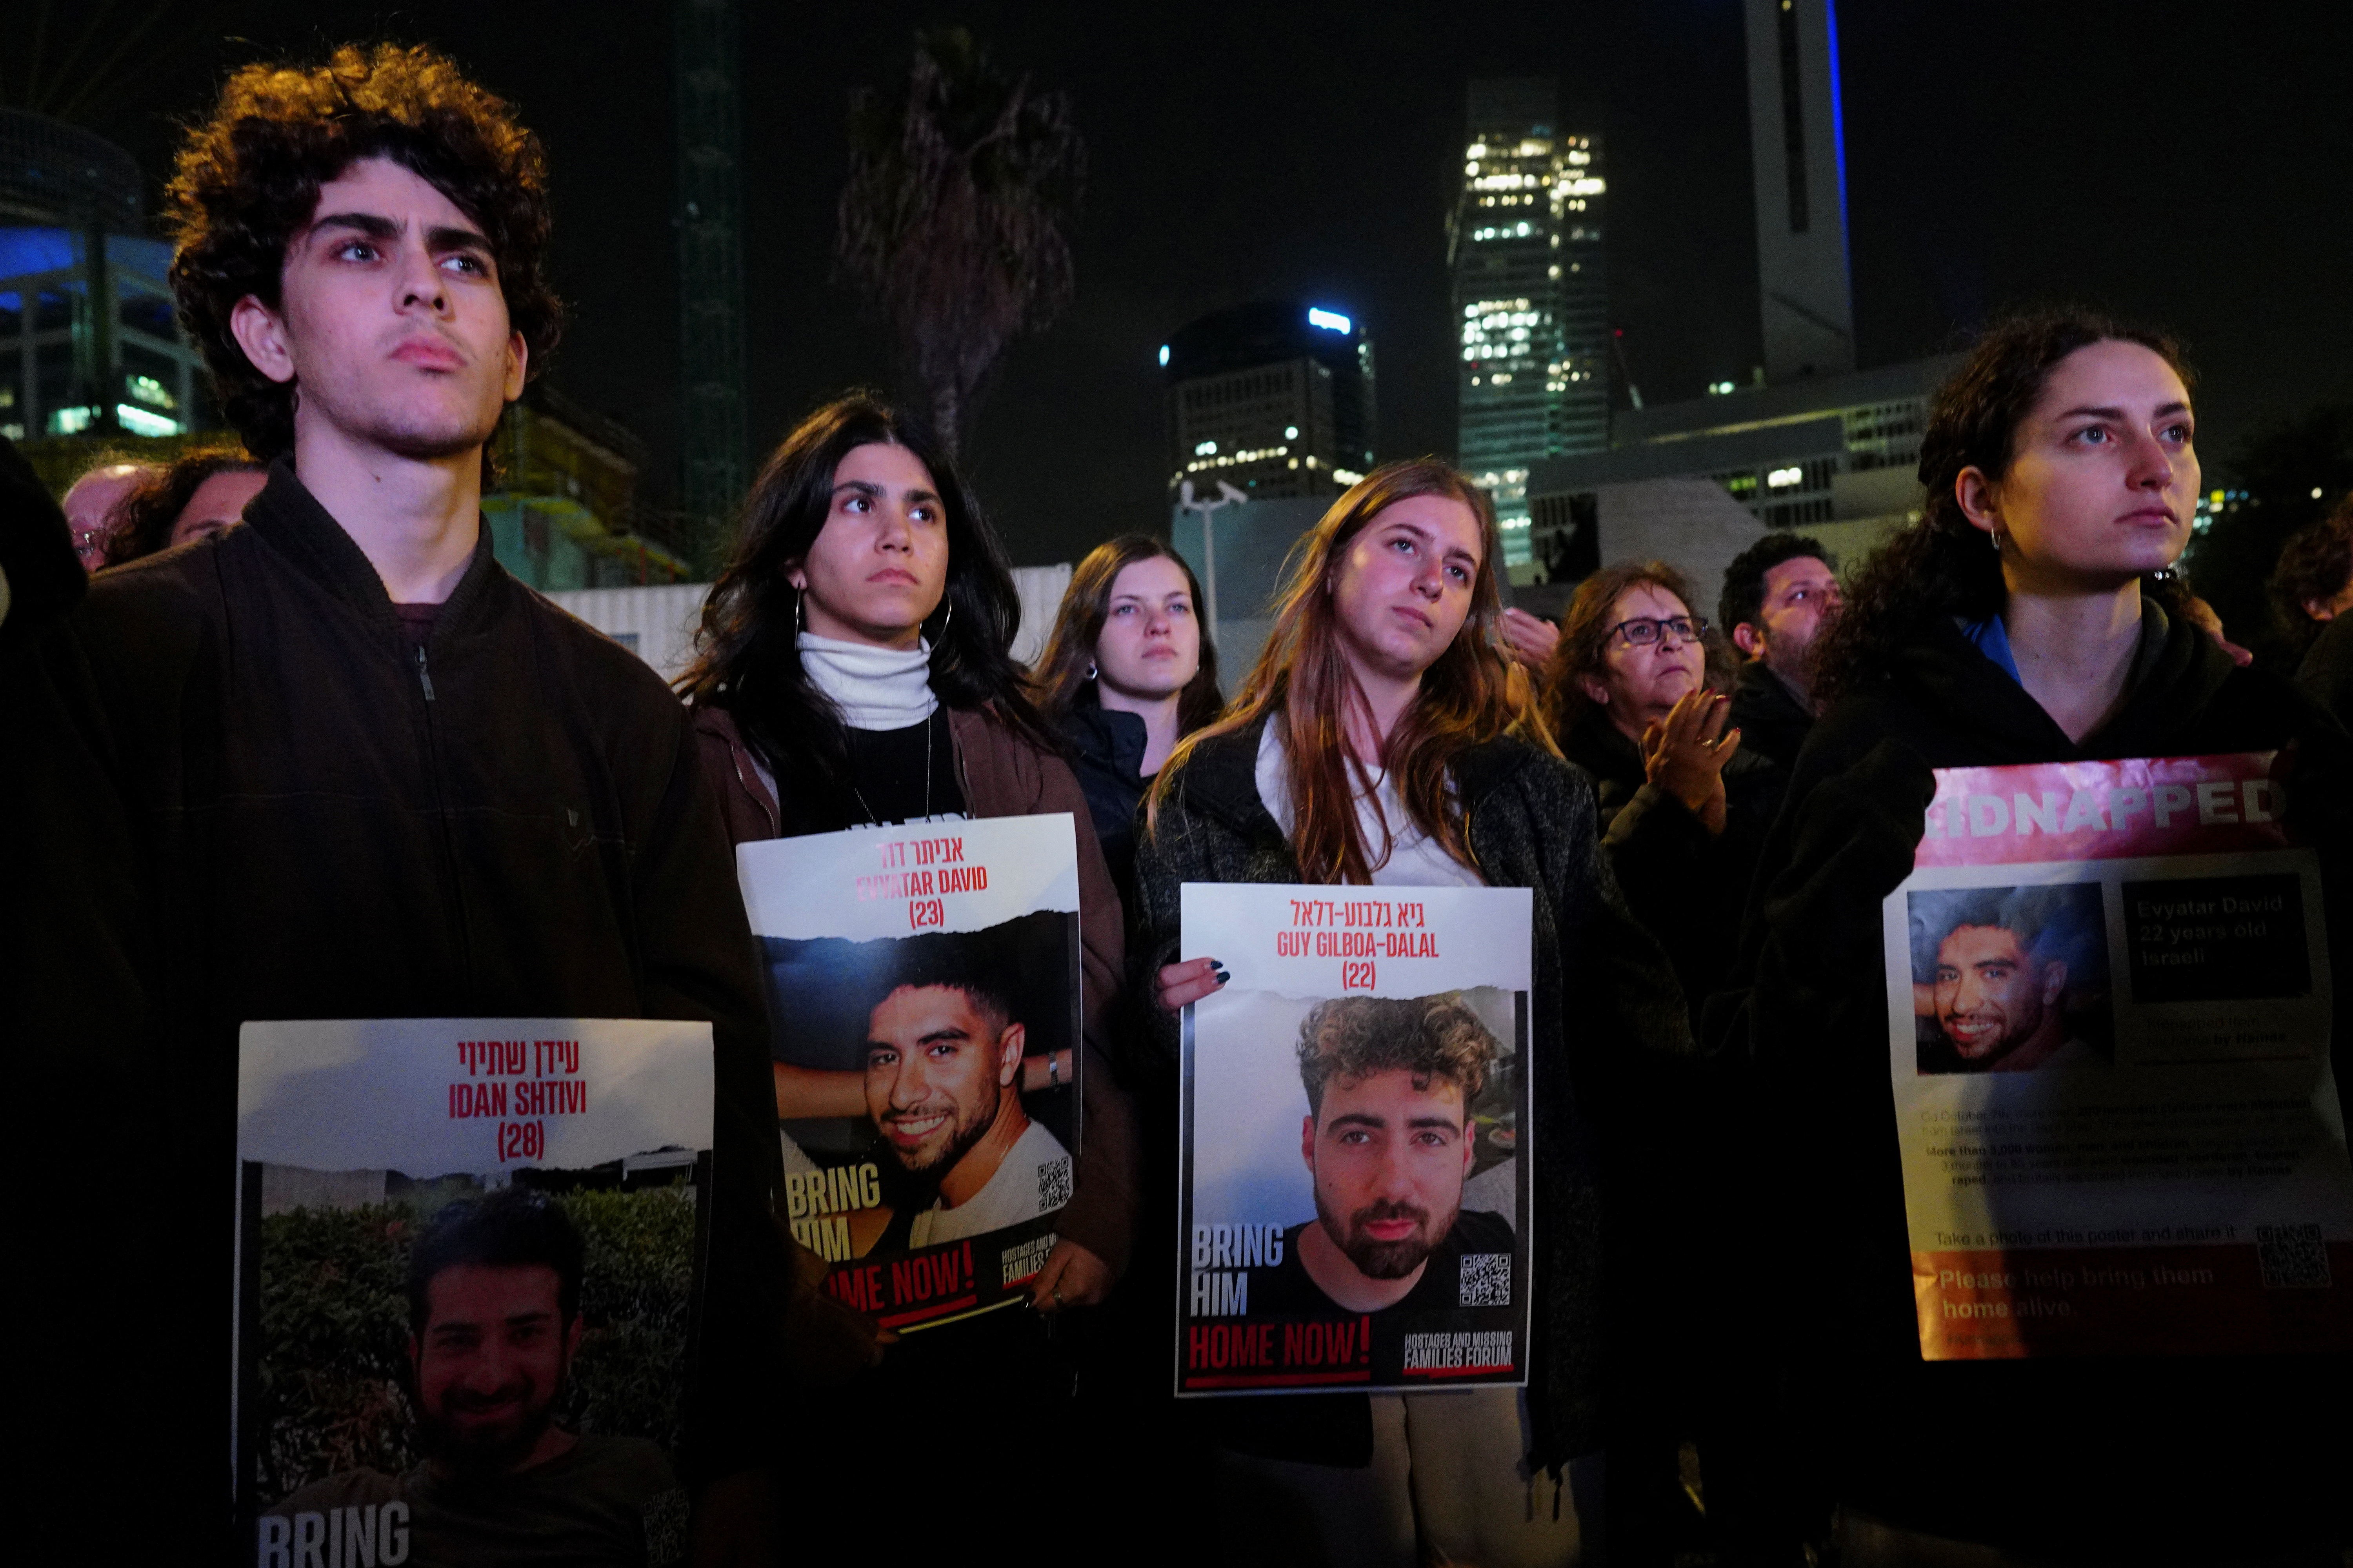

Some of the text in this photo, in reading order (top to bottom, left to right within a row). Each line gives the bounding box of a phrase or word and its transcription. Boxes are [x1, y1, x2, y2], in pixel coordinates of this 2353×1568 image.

[876, 837, 964, 868] אביתר דוד
[856, 865, 987, 902] EVYATAR DAVID
[909, 898, 944, 930] (23)
[1290, 899, 1425, 928] גיא גלבוע-דלאל
[2138, 895, 2282, 920] Evyatar David
[1277, 932, 1439, 958] GUY GILBOA-DALAL
[2140, 920, 2267, 945] 22 years old
[2142, 948, 2205, 966] Israeli
[1343, 961, 1376, 991] (22)
[2214, 1033, 2231, 1046] by
[458, 1041, 578, 1077] עידן שתיוי
[449, 1081, 586, 1118] IDAN SHTIVI
[498, 1120, 544, 1162] (28)
[1926, 1145, 1955, 1156] More
[1960, 1145, 1986, 1156] than
[1990, 1143, 2022, 1156] 3,000
[2228, 1166, 2243, 1178] by
[785, 1162, 880, 1216] BRING
[1002, 1239, 1035, 1265] HOSTAGES
[1036, 1235, 1048, 1253] AND
[1192, 1223, 1284, 1269] BRING
[1938, 1224, 2235, 1248] Take a photo of this poster and share it
[829, 1265, 885, 1312] ME
[1940, 1264, 2214, 1290] Please help bring them
[1191, 1271, 1247, 1317] HIM
[1943, 1296, 2078, 1319] home alive.
[1189, 1324, 1274, 1370] HOME
[1405, 1331, 1513, 1349] HOSTAGES AND MISSING
[1404, 1346, 1512, 1369] FAMILIES FORUM
[258, 1500, 410, 1568] BRING
